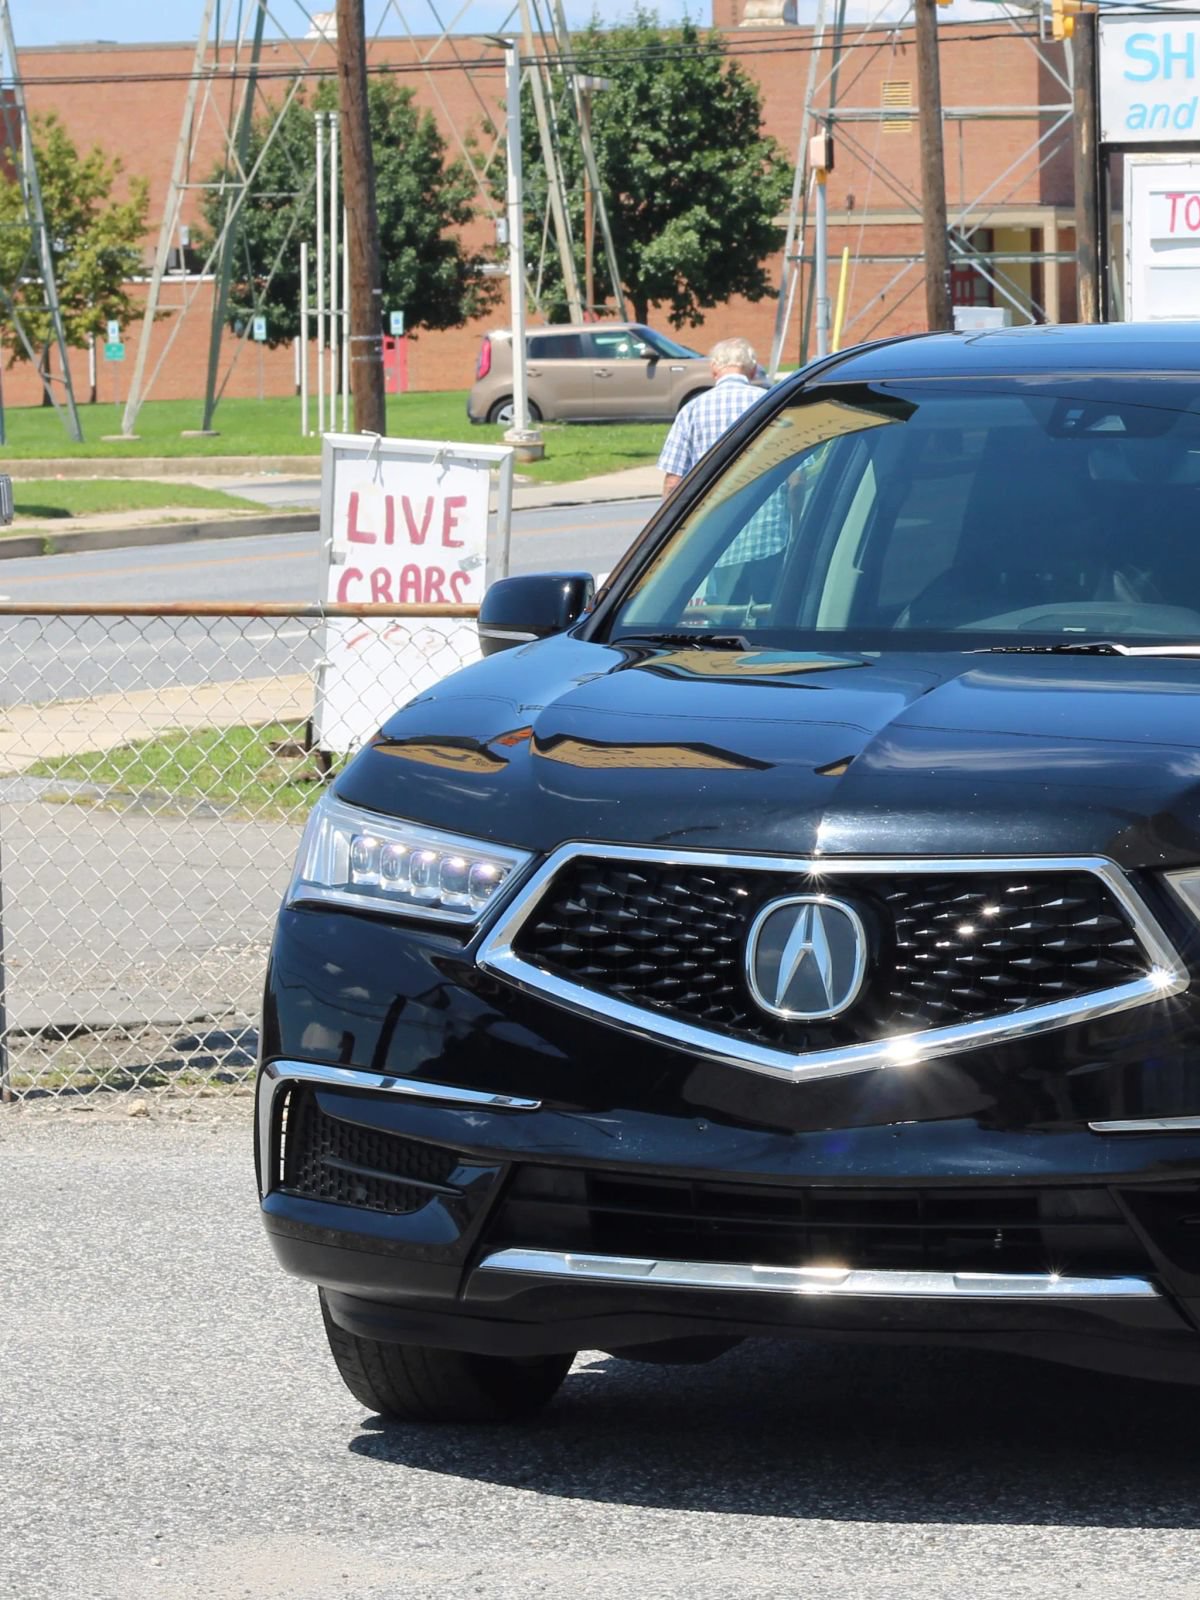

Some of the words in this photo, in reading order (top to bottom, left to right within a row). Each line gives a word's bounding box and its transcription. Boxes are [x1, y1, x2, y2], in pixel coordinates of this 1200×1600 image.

[1127, 96, 1198, 130] and
[347, 491, 467, 548] LIVE
[337, 563, 471, 604] CRABS
